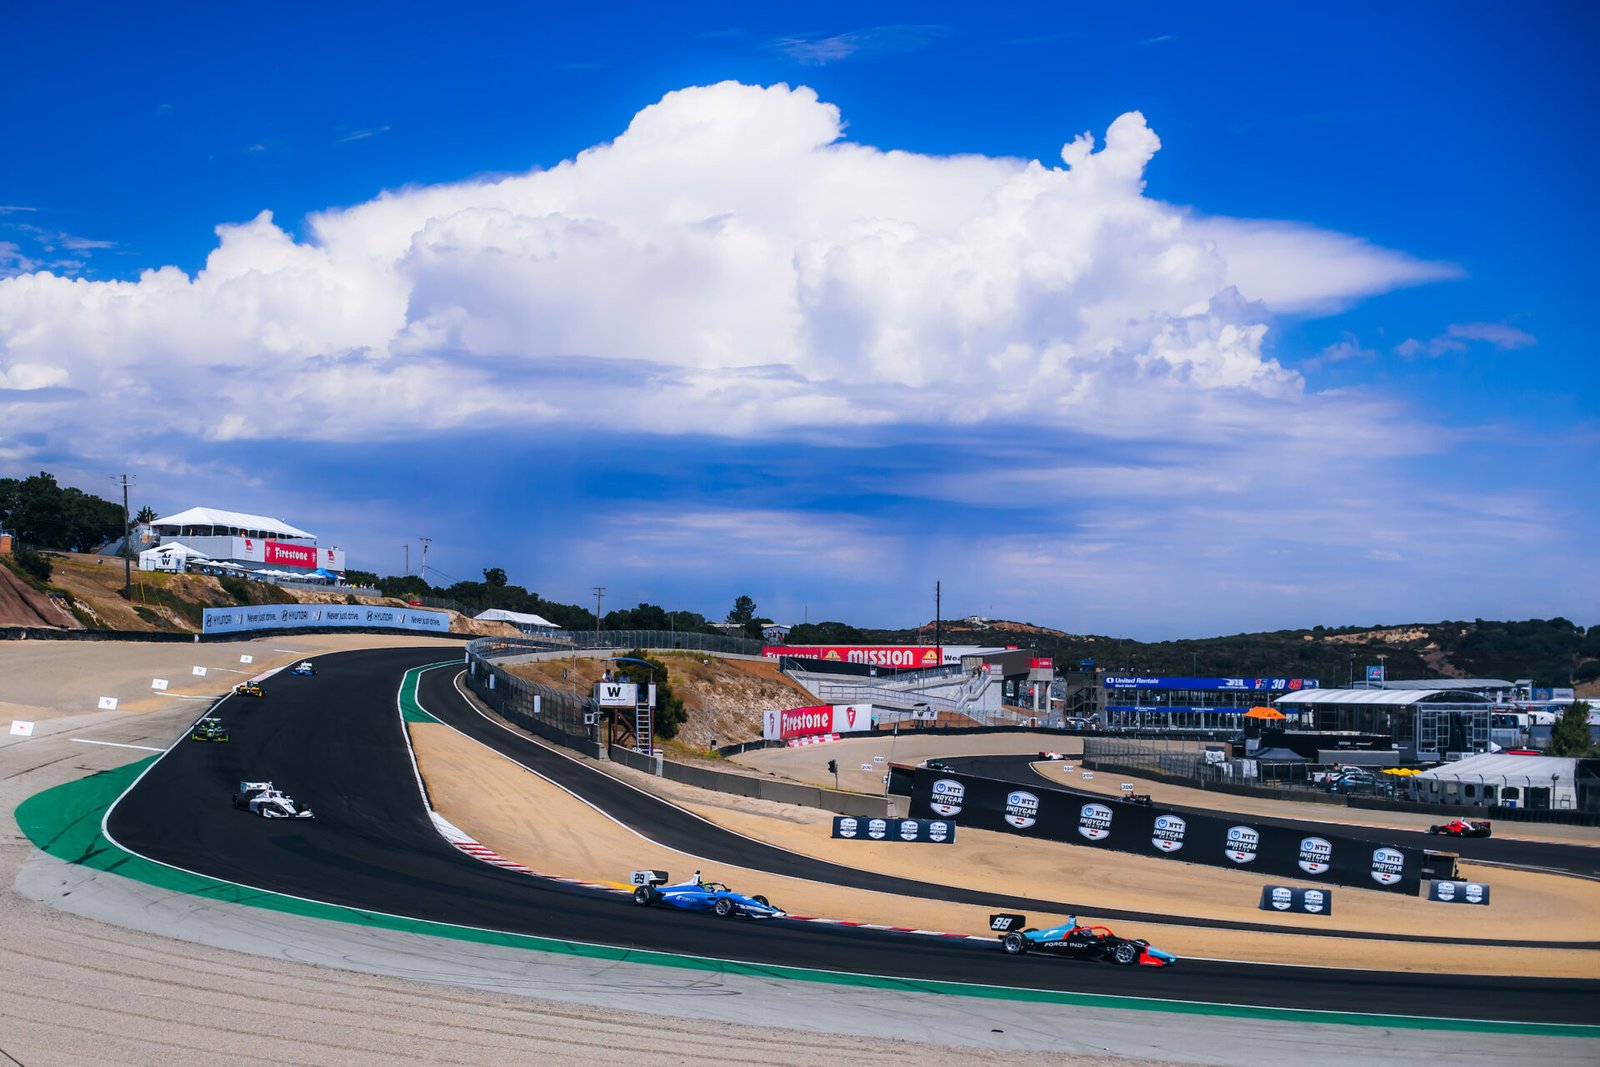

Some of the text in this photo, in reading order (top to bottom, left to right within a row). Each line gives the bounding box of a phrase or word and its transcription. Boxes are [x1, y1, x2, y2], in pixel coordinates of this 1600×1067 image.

[275, 546, 308, 560] Firestone
[847, 650, 913, 665] MISSION
[1271, 679, 1286, 689] 30
[607, 687, 621, 697] W
[782, 712, 829, 736] Firestone
[932, 793, 962, 803] INDYCAR
[1006, 805, 1037, 815] INDYCAR
[1080, 817, 1111, 827] INDYCAR
[1153, 829, 1184, 839] INDYCAR
[1226, 840, 1257, 850] INDYCAR
[1300, 851, 1330, 861] INDYCAR
[1372, 862, 1403, 872] INDYCAR
[634, 873, 645, 884] 29
[992, 917, 1013, 929] 99
